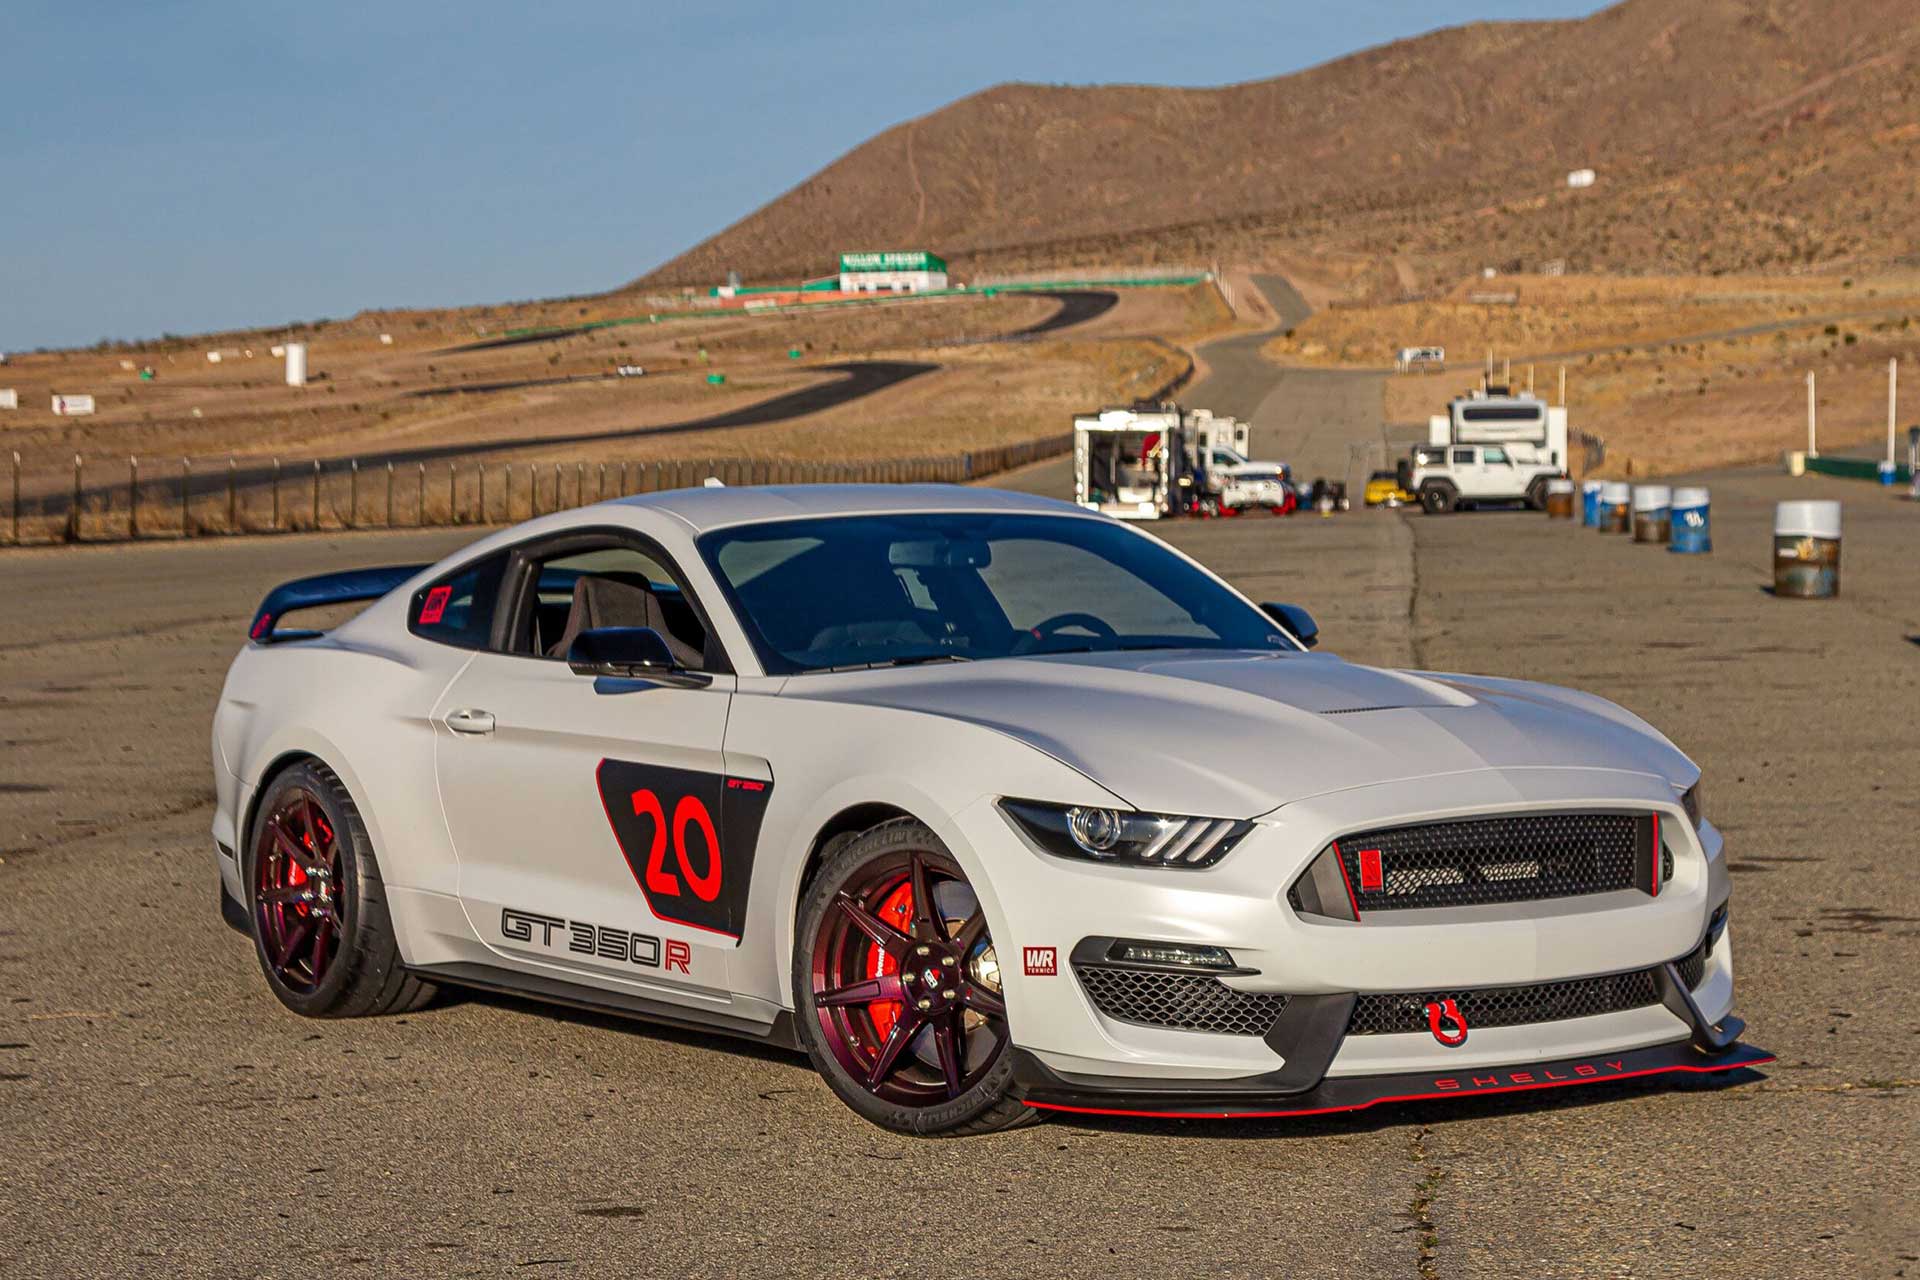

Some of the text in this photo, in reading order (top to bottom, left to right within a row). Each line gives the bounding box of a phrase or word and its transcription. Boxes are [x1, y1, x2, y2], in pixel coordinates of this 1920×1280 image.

[631, 788, 723, 903] 20
[874, 946, 886, 978] bremb
[1026, 949, 1054, 967] WR
[1434, 1060, 1625, 1091] SHELBY
